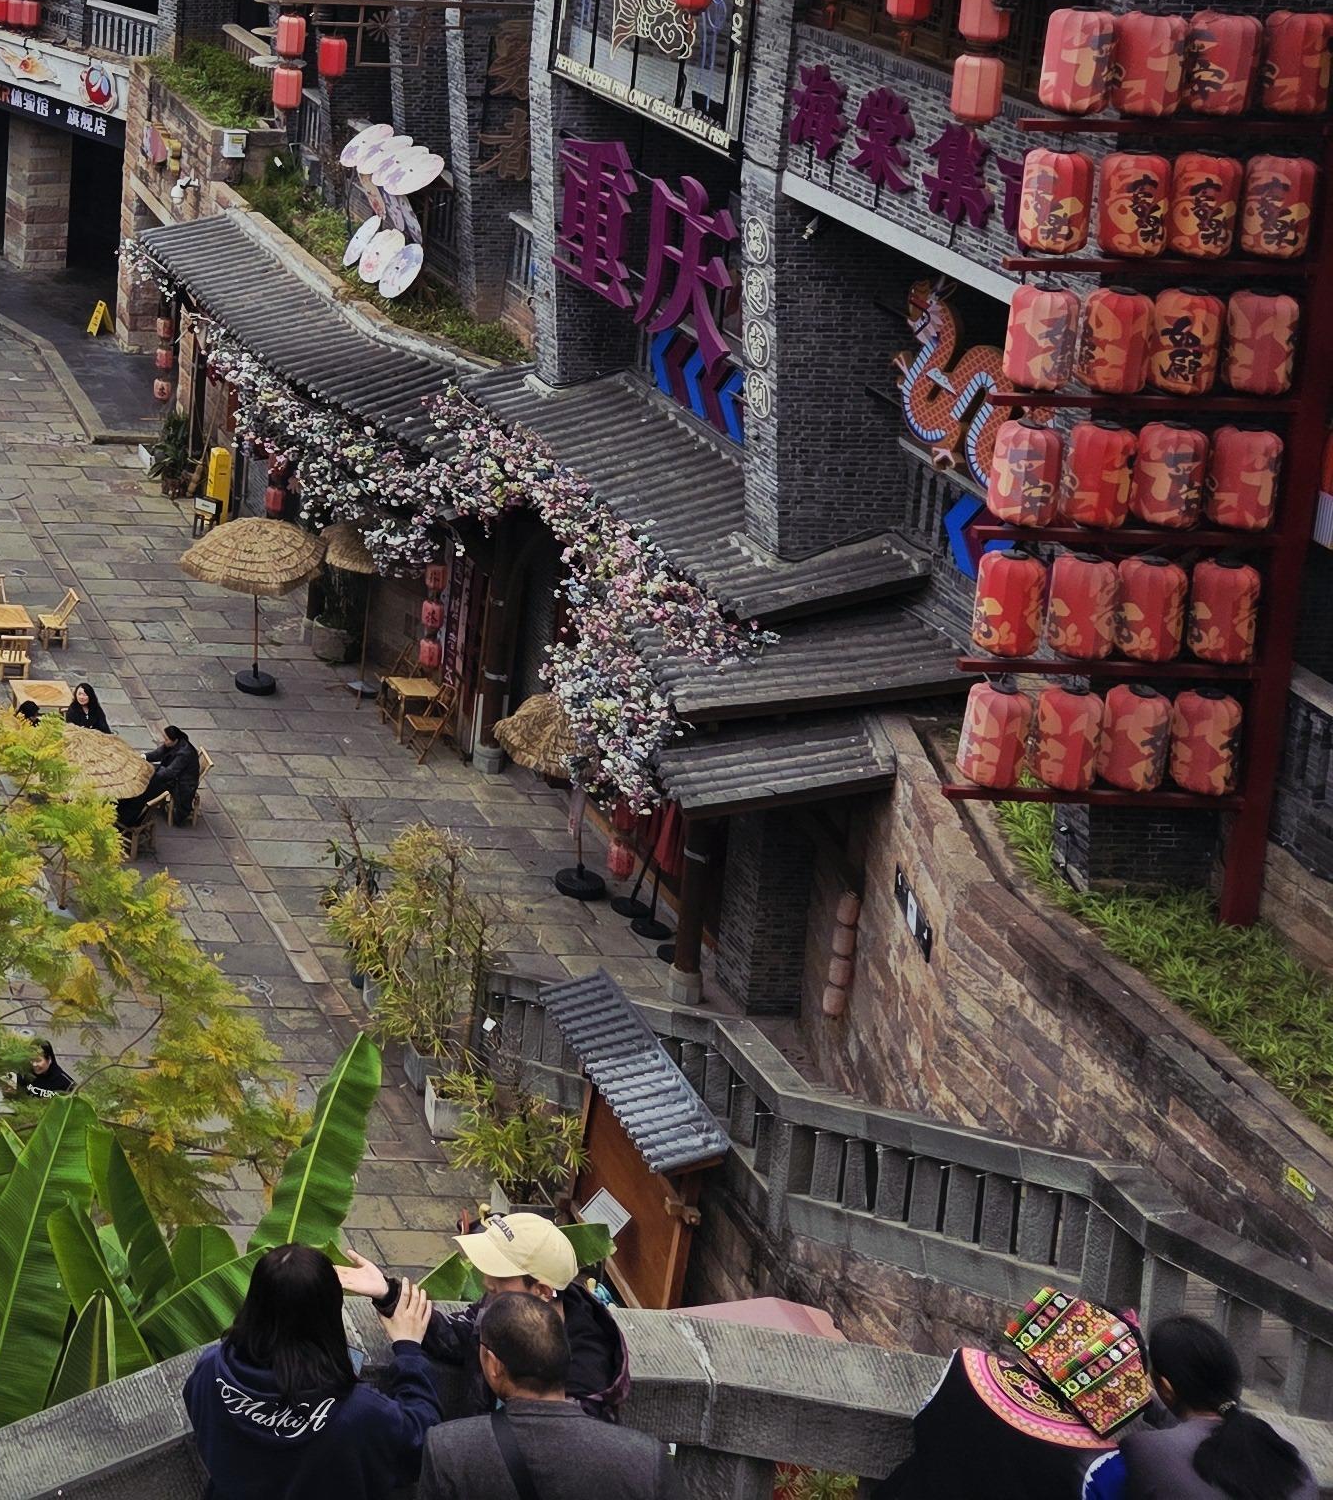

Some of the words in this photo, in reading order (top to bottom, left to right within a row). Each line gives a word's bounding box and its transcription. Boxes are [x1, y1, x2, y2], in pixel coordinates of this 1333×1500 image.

[730, 12, 744, 45] ON
[554, 53, 583, 80] REFUSE
[582, 66, 612, 91] FROZEN
[612, 78, 630, 99] FISH
[629, 88, 652, 110] ONLY
[652, 97, 680, 124] SELECT
[681, 112, 709, 139] LIVELY
[708, 124, 731, 150] FISH
[551, 137, 739, 374] 重庆
